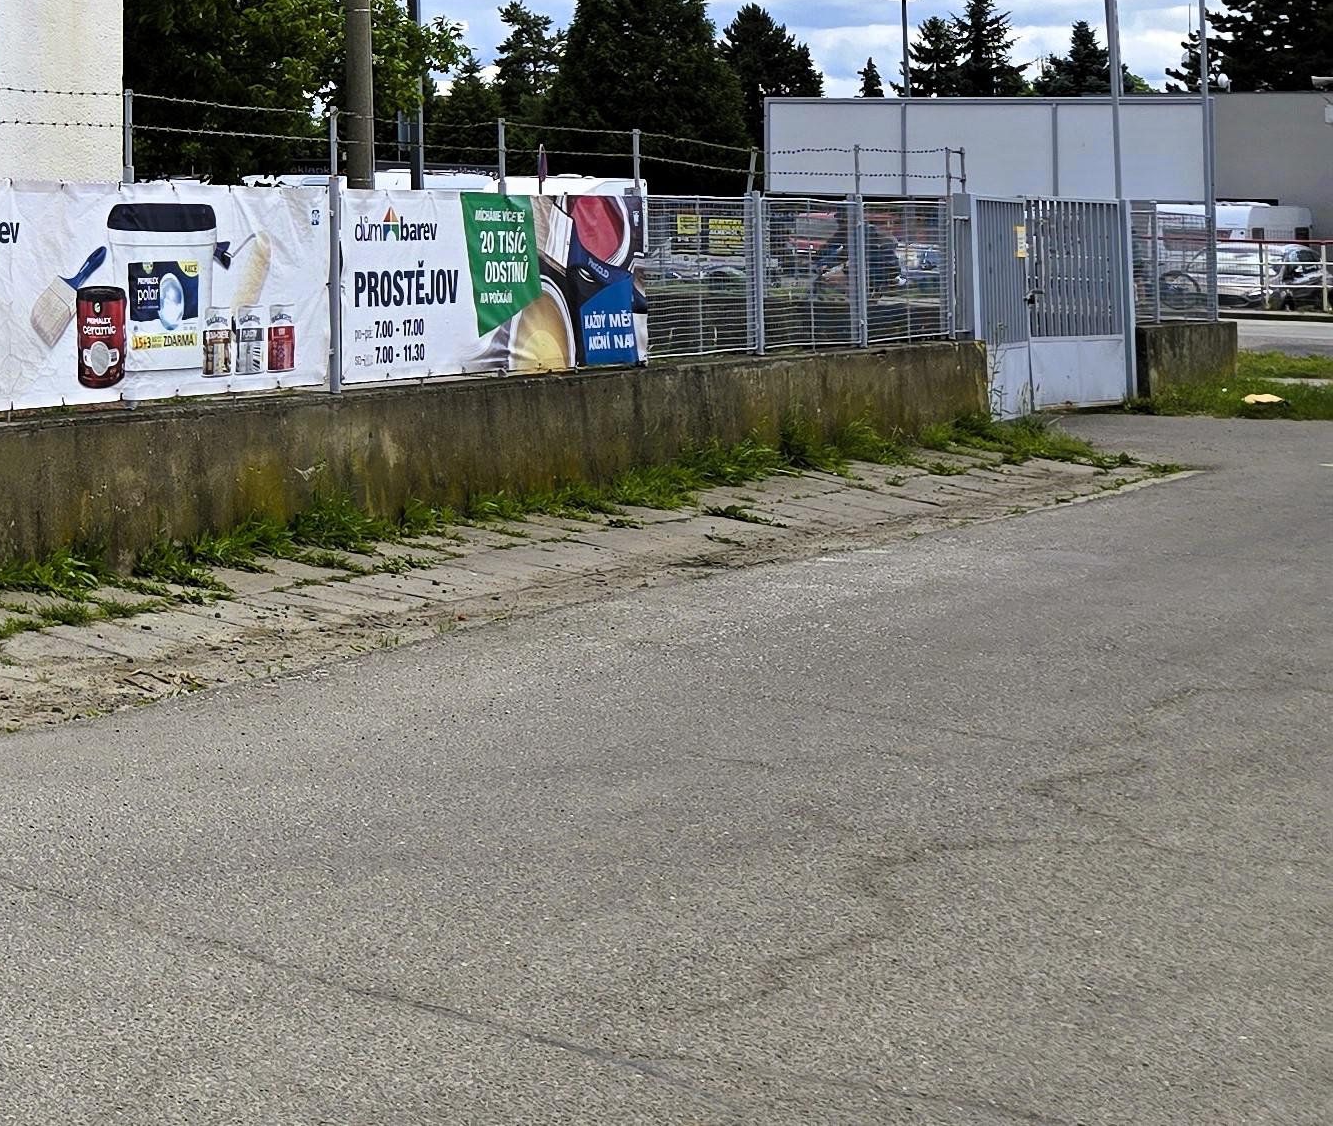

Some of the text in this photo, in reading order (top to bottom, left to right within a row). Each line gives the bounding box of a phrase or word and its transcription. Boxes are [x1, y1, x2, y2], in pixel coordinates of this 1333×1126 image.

[354, 215, 438, 242] dům barev
[479, 226, 527, 254] 20 TISÍC
[484, 255, 529, 283] ODSTÍNŮ
[354, 260, 459, 307] PROSTĚJOV
[137, 285, 159, 304] polar
[82, 323, 117, 335] ceramic
[375, 320, 393, 338] 7.00
[402, 318, 425, 336] 17.00
[583, 310, 607, 329] KAŽDÝ
[588, 331, 611, 350] AKČNÍ
[375, 345, 394, 364] 7.00
[403, 343, 425, 362] 11.30
